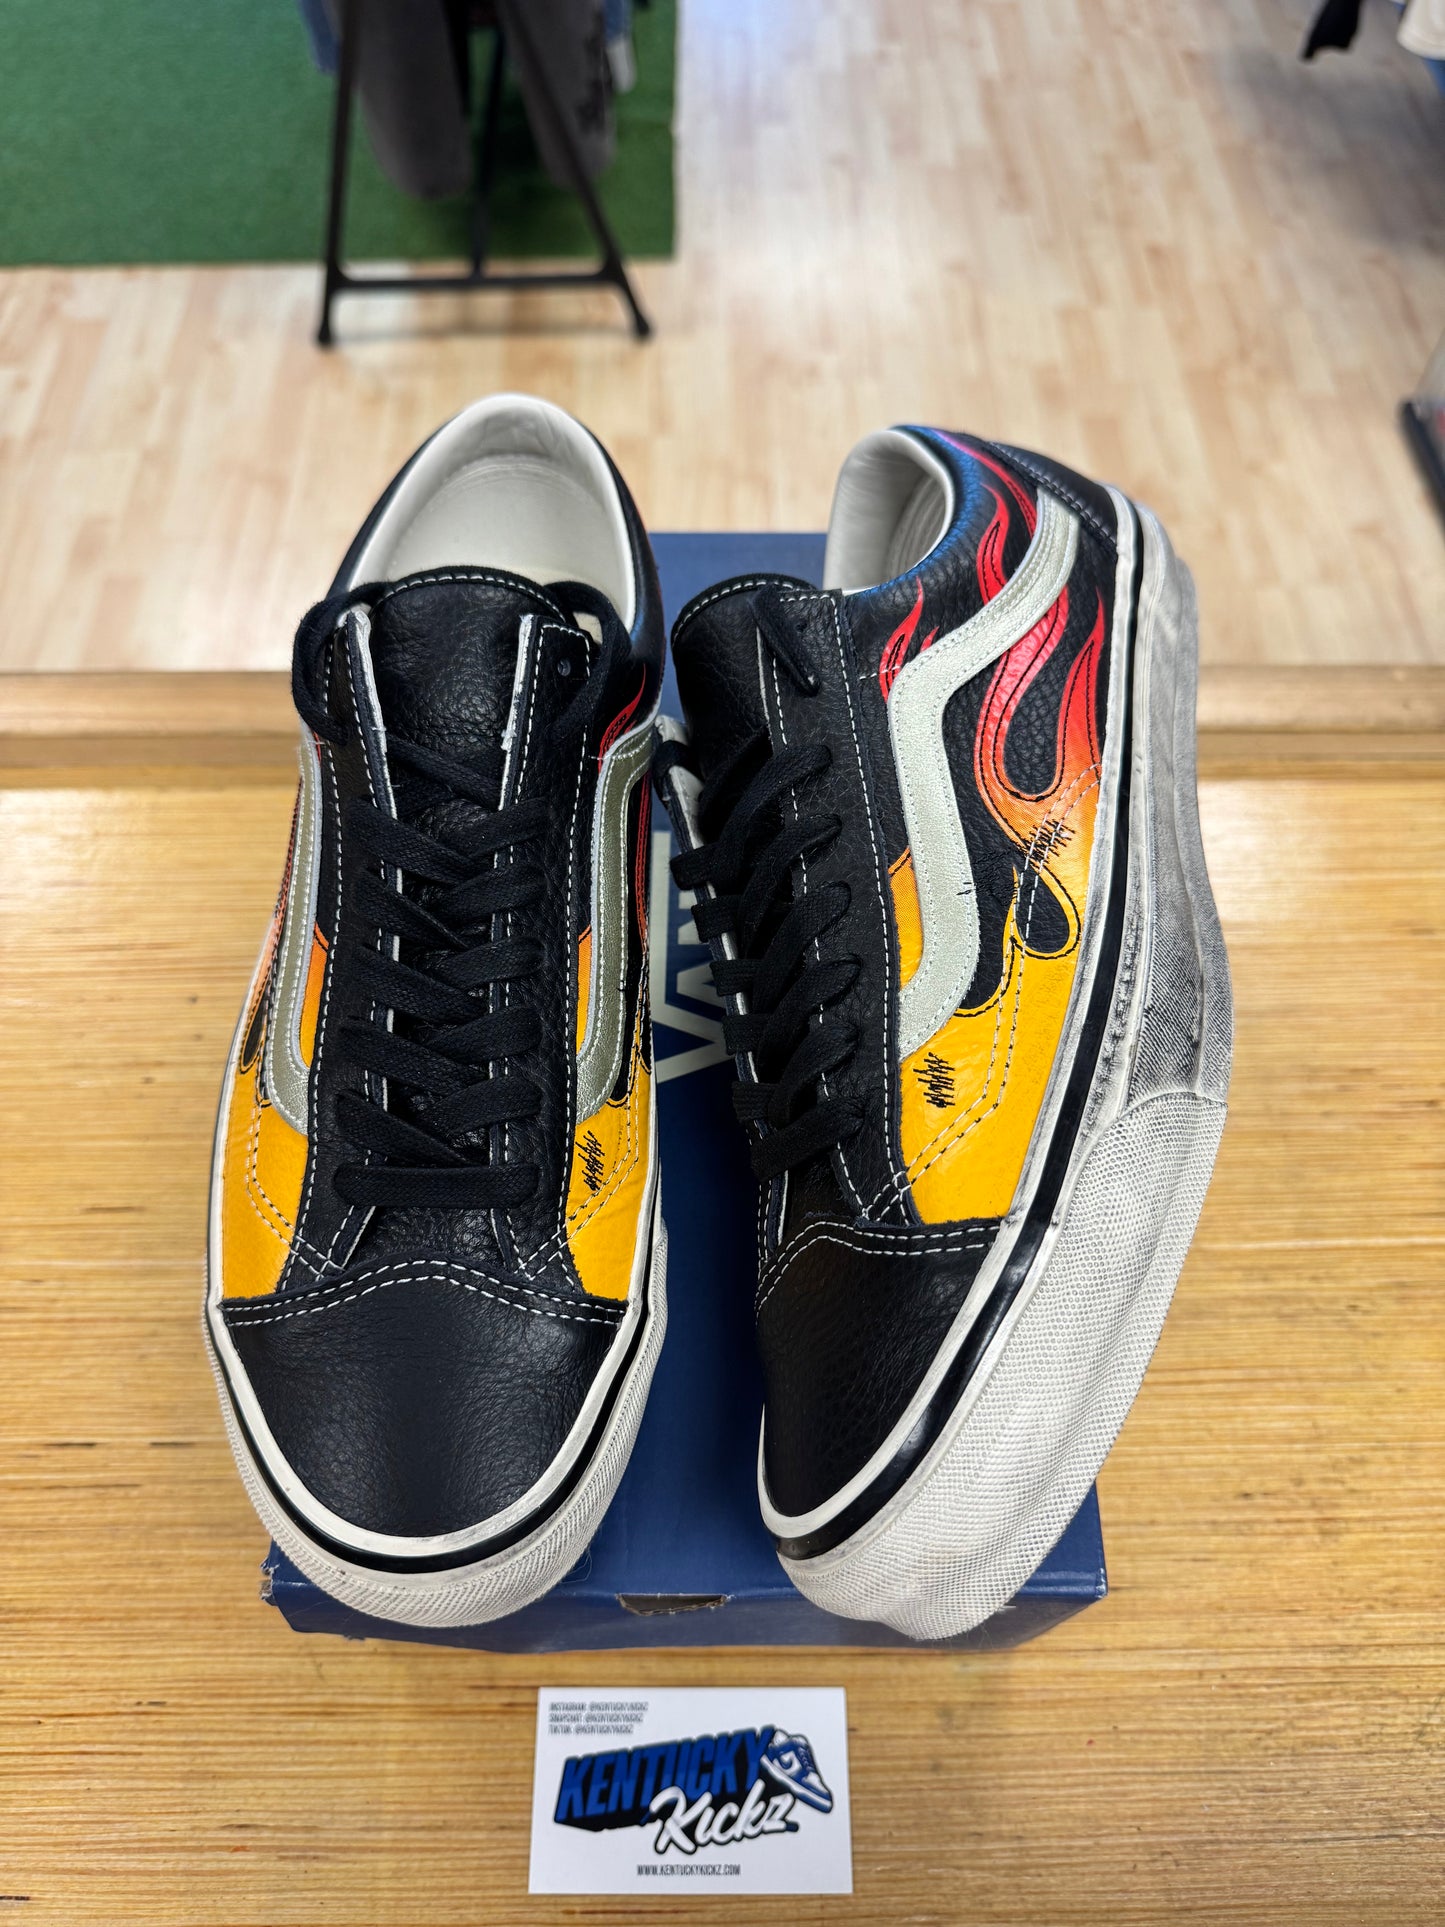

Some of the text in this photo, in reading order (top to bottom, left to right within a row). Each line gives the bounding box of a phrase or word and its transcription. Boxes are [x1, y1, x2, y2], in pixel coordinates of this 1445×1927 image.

[650, 831, 737, 1083] VA
[555, 1725, 775, 1822] KENTUCKY
[637, 1864, 740, 1875] WWW.KENTUCKYKICKZ.COM
